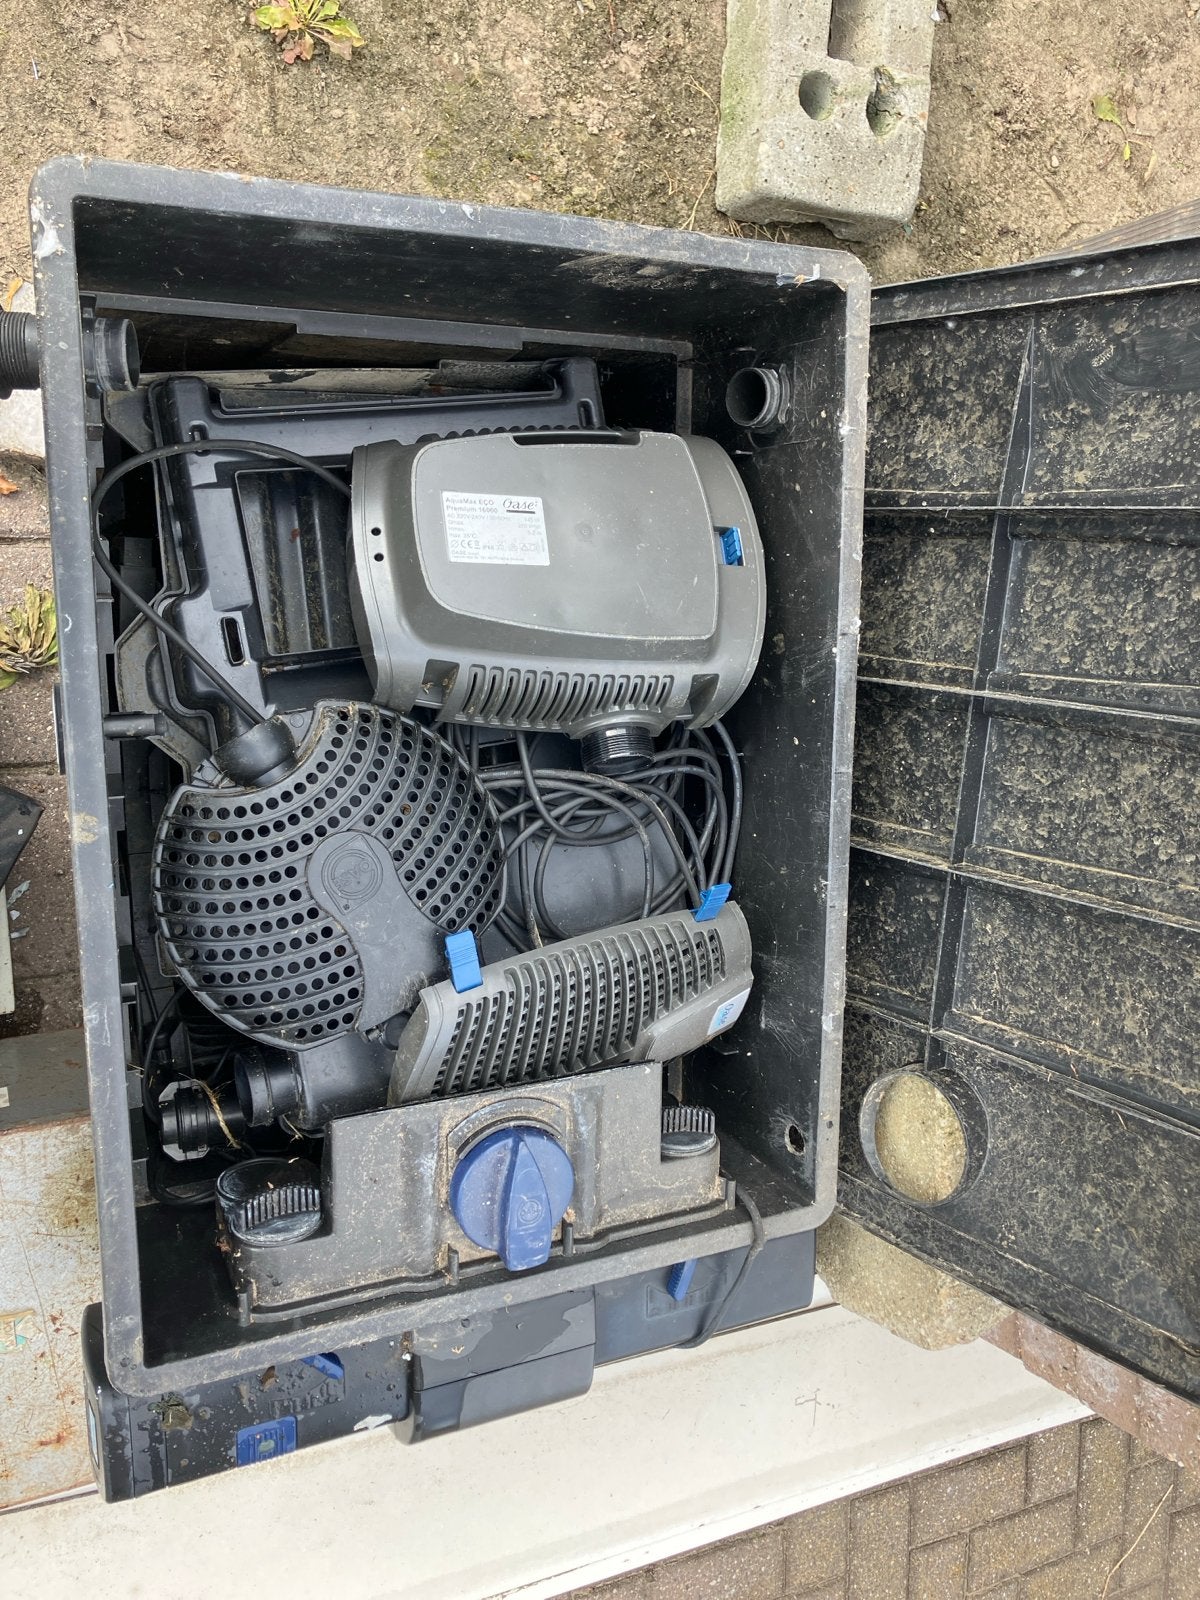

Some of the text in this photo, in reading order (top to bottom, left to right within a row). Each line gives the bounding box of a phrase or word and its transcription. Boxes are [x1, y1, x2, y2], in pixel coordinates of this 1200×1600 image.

[445, 497, 495, 506] AquaMax ECO
[503, 498, 535, 510] Oase
[446, 505, 477, 513] Premium
